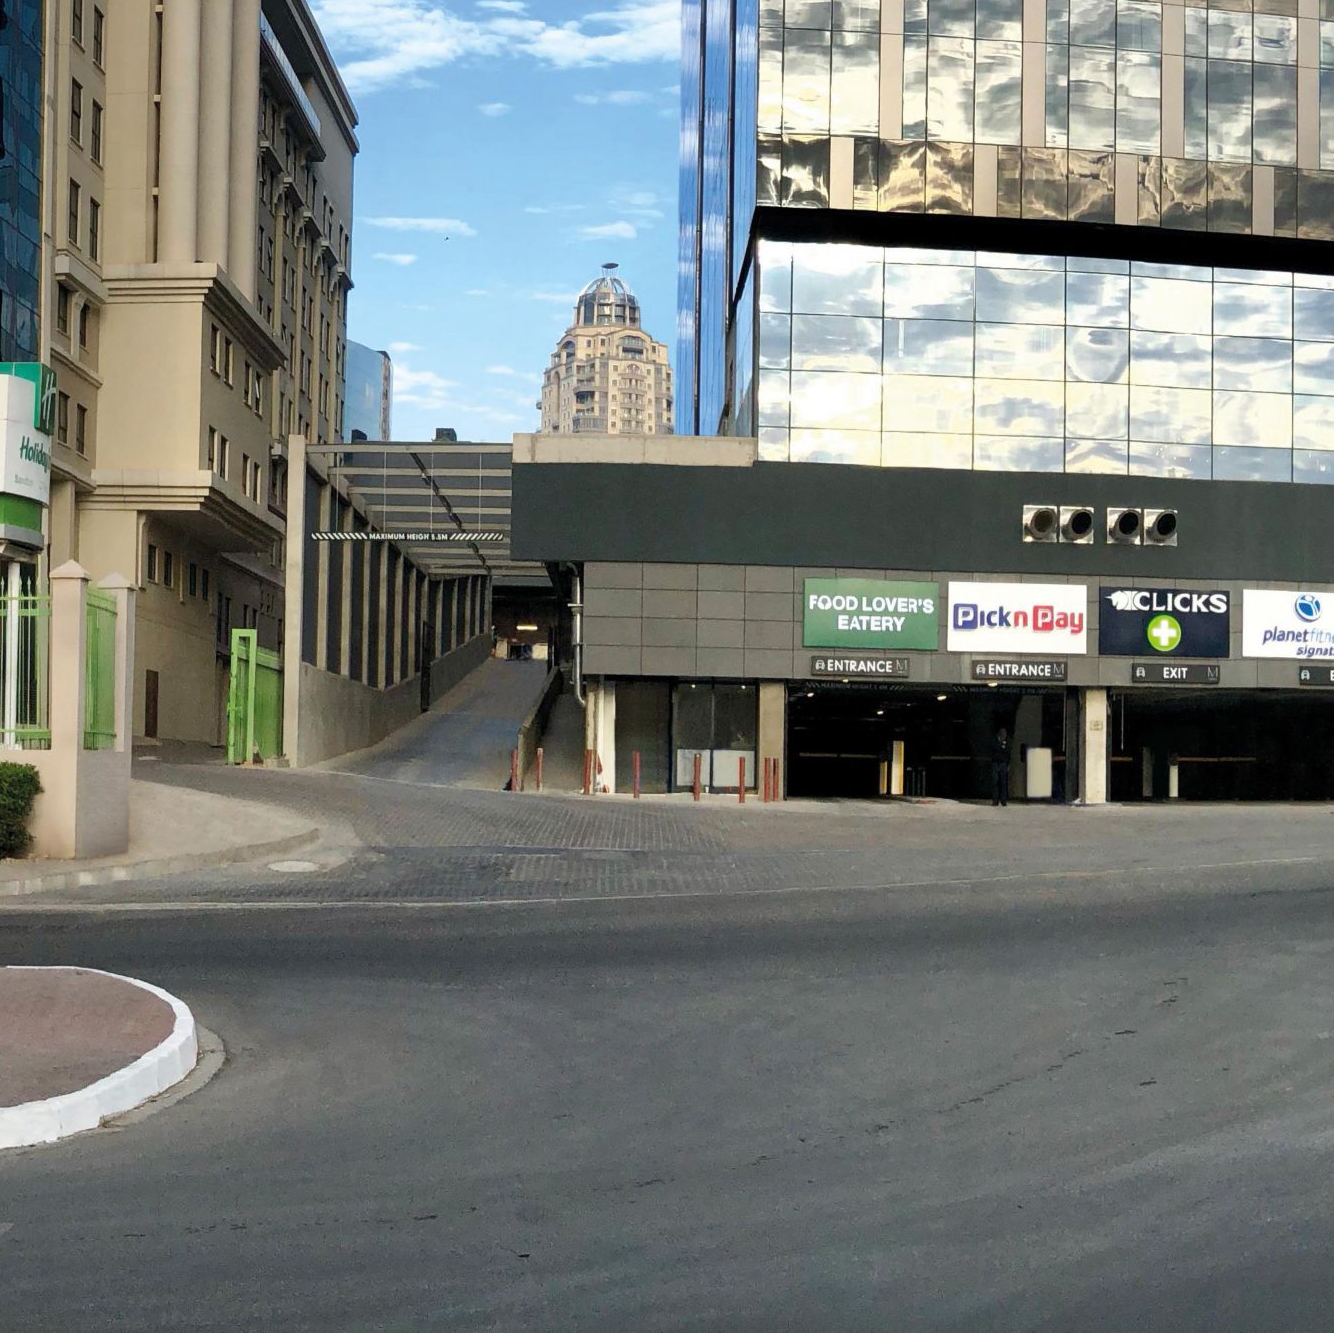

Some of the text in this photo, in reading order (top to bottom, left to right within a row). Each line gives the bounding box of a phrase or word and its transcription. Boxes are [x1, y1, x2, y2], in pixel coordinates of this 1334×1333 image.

[809, 595, 934, 614] FOOD LOVER'S
[1133, 591, 1228, 614] CLICKS
[837, 615, 905, 632] EATERY
[953, 603, 1011, 631] Pick
[1032, 605, 1084, 634] Pay
[827, 659, 893, 673] ENTRANCE
[988, 663, 1051, 677] ENTRANCE
[1163, 667, 1188, 679] EXIT
